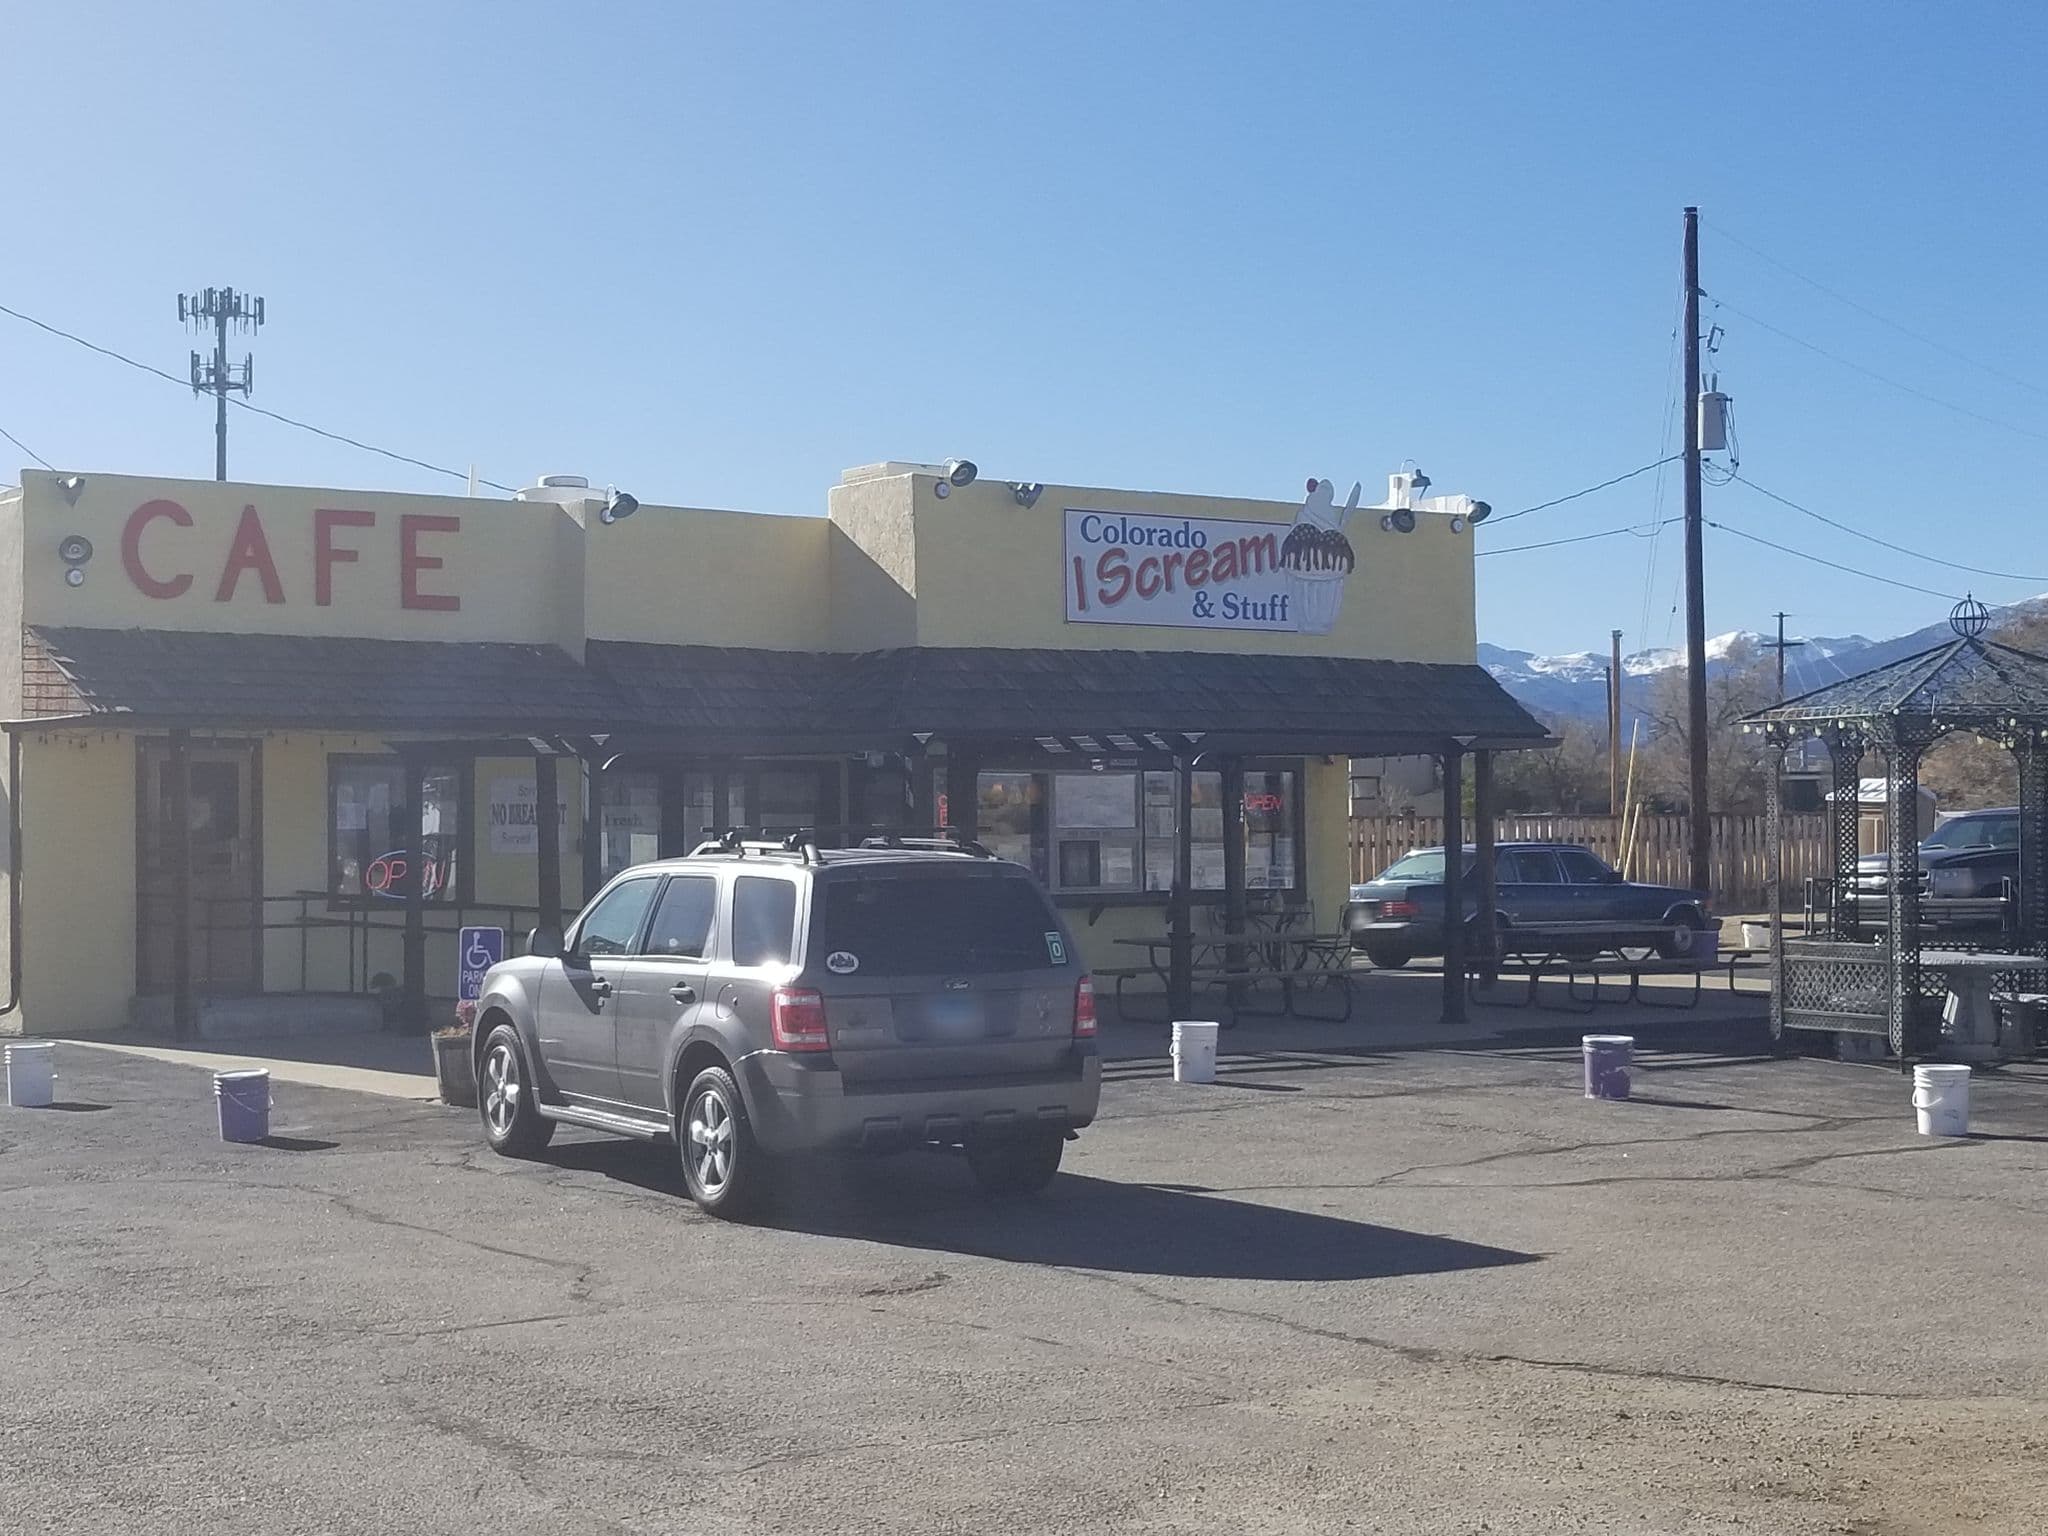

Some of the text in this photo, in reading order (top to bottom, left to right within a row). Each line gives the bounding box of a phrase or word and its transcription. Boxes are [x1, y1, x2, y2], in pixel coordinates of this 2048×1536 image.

[1080, 514, 1207, 550] Colorado
[121, 498, 461, 612] CAFE
[1073, 532, 1280, 612] I Scream
[1192, 590, 1289, 622] & Stuff
[366, 860, 446, 890] OPN
[463, 970, 486, 983] PARK
